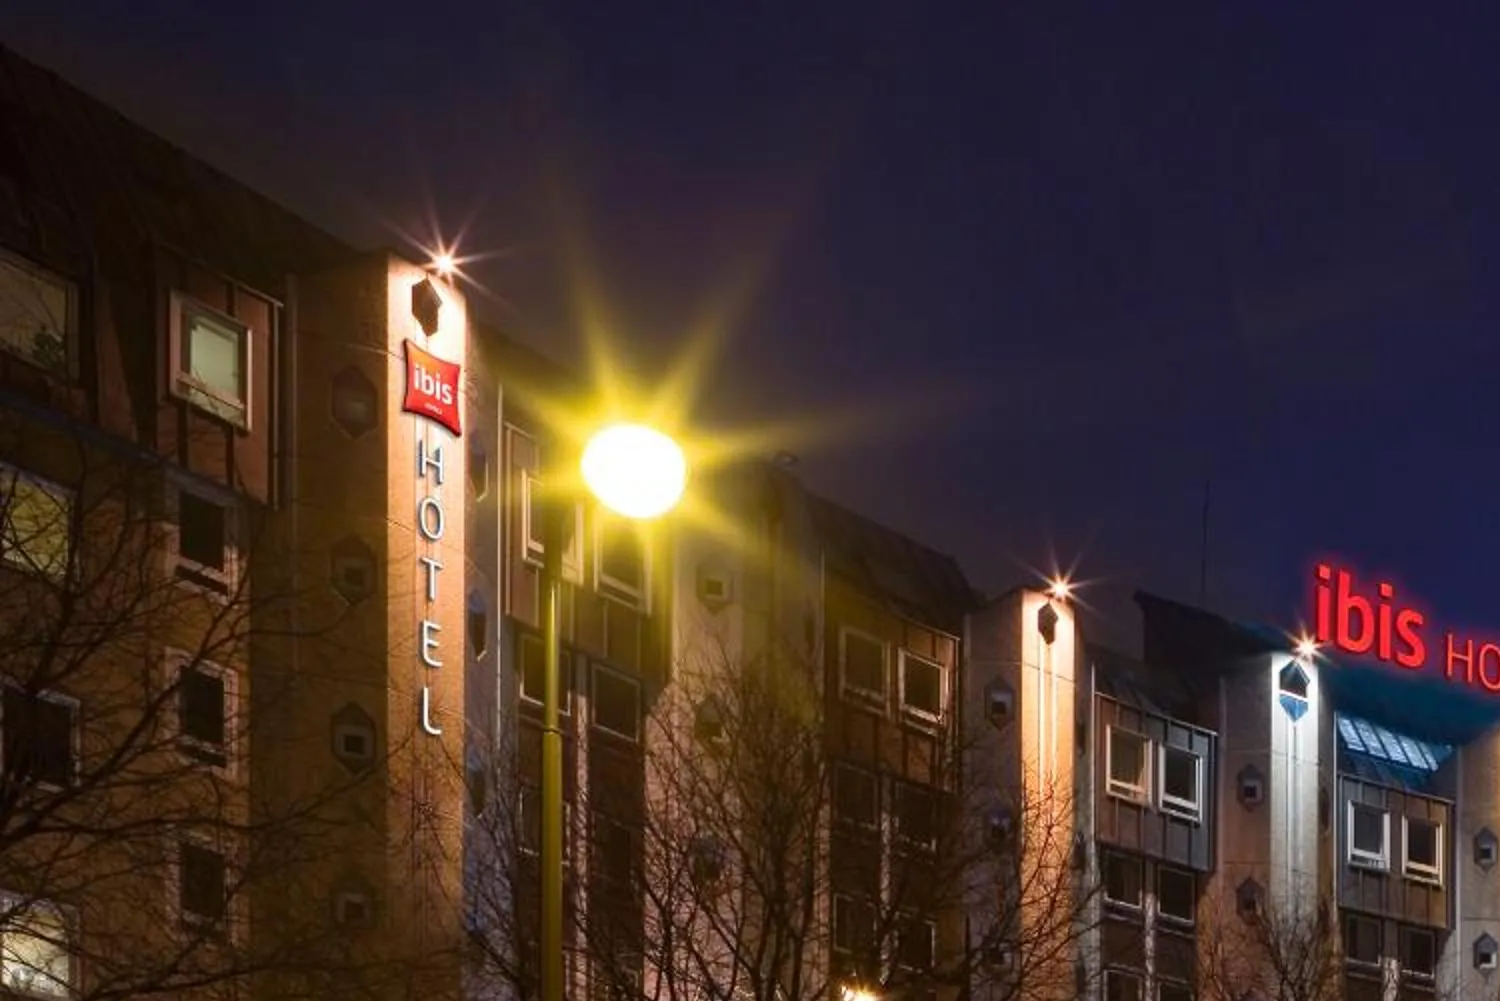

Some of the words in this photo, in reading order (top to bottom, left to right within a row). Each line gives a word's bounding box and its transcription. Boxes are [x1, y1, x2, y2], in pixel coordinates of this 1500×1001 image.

[414, 364, 453, 405] ibis
[416, 439, 446, 737] HOTEL
[1314, 564, 1427, 668] ibis
